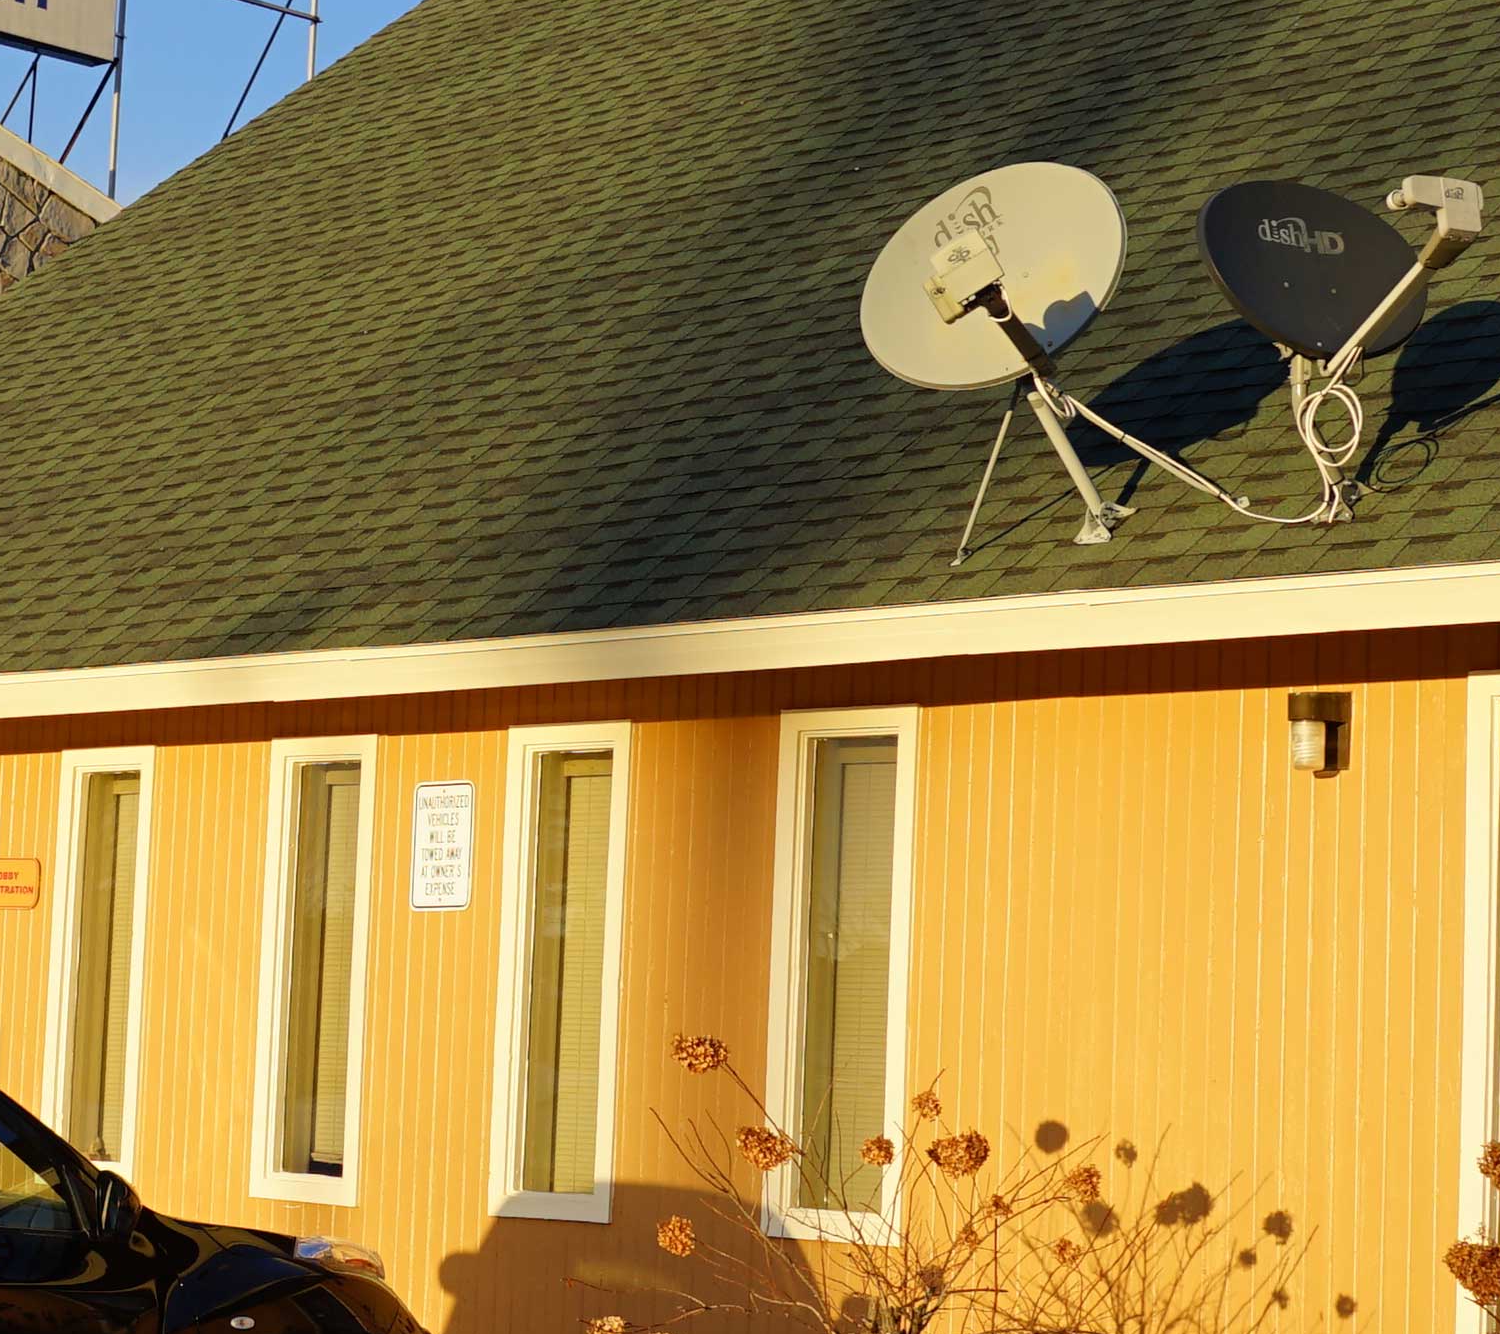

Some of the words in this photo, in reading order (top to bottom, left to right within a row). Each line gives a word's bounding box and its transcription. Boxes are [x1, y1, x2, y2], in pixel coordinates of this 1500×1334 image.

[419, 795, 470, 810] UNAUTHORIZED
[427, 812, 459, 827] VEHICLES
[428, 830, 444, 844] WILL
[446, 829, 456, 843] BE
[421, 848, 443, 861] TOWED
[446, 847, 463, 860] AWAY
[420, 865, 428, 878] AT
[424, 882, 456, 896] EXPENSE
